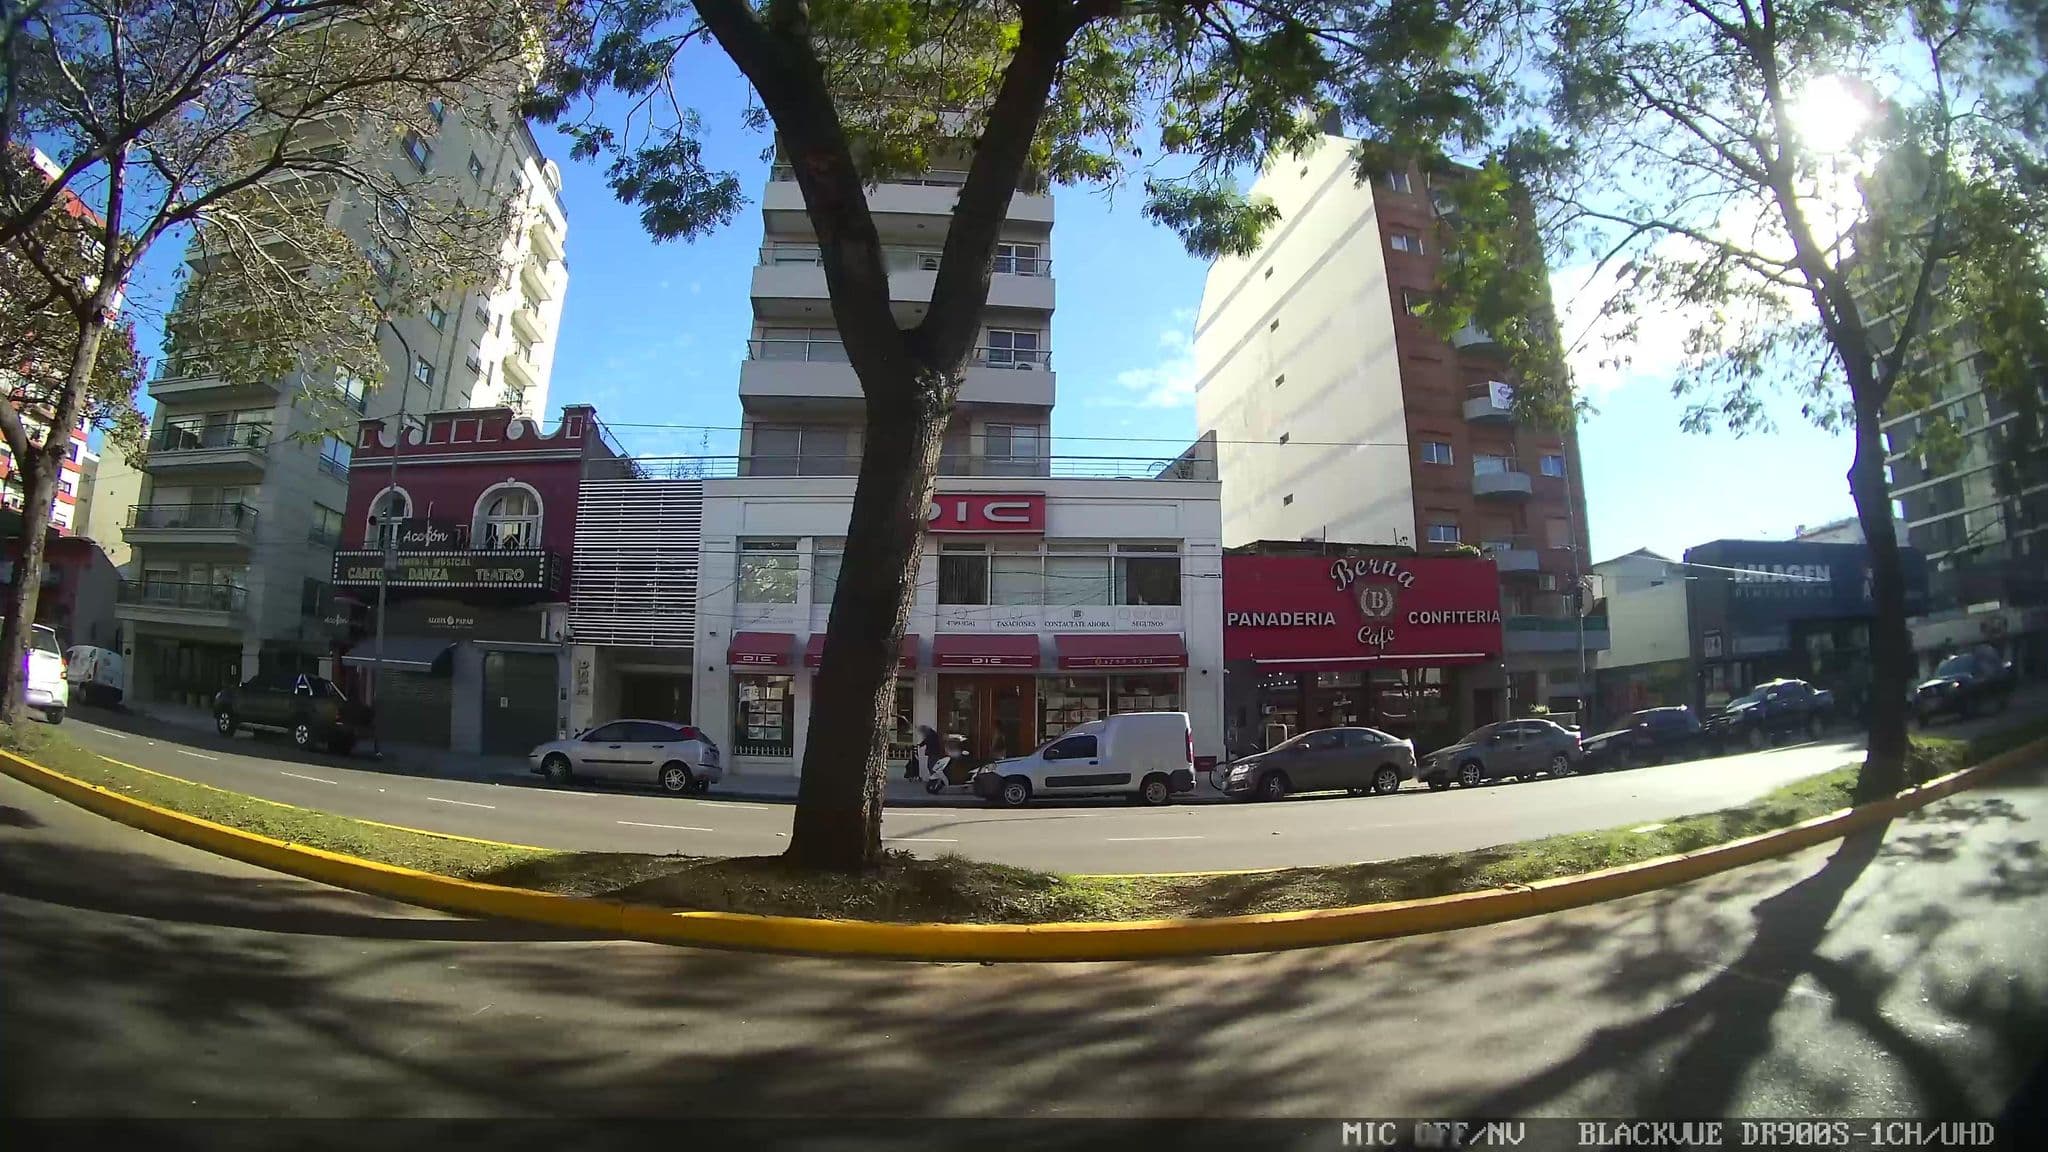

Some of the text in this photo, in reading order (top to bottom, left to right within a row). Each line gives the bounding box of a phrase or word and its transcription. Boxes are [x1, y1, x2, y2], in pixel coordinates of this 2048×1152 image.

[928, 502, 1030, 521] IC
[433, 558, 471, 567] MUSICAL
[408, 567, 449, 581] DANZA
[476, 568, 525, 582] TEATRO
[1330, 558, 1415, 591] Berna
[1370, 591, 1385, 609] B
[1227, 611, 1336, 626] PANADERIA
[1408, 610, 1501, 624] CONFITERIA
